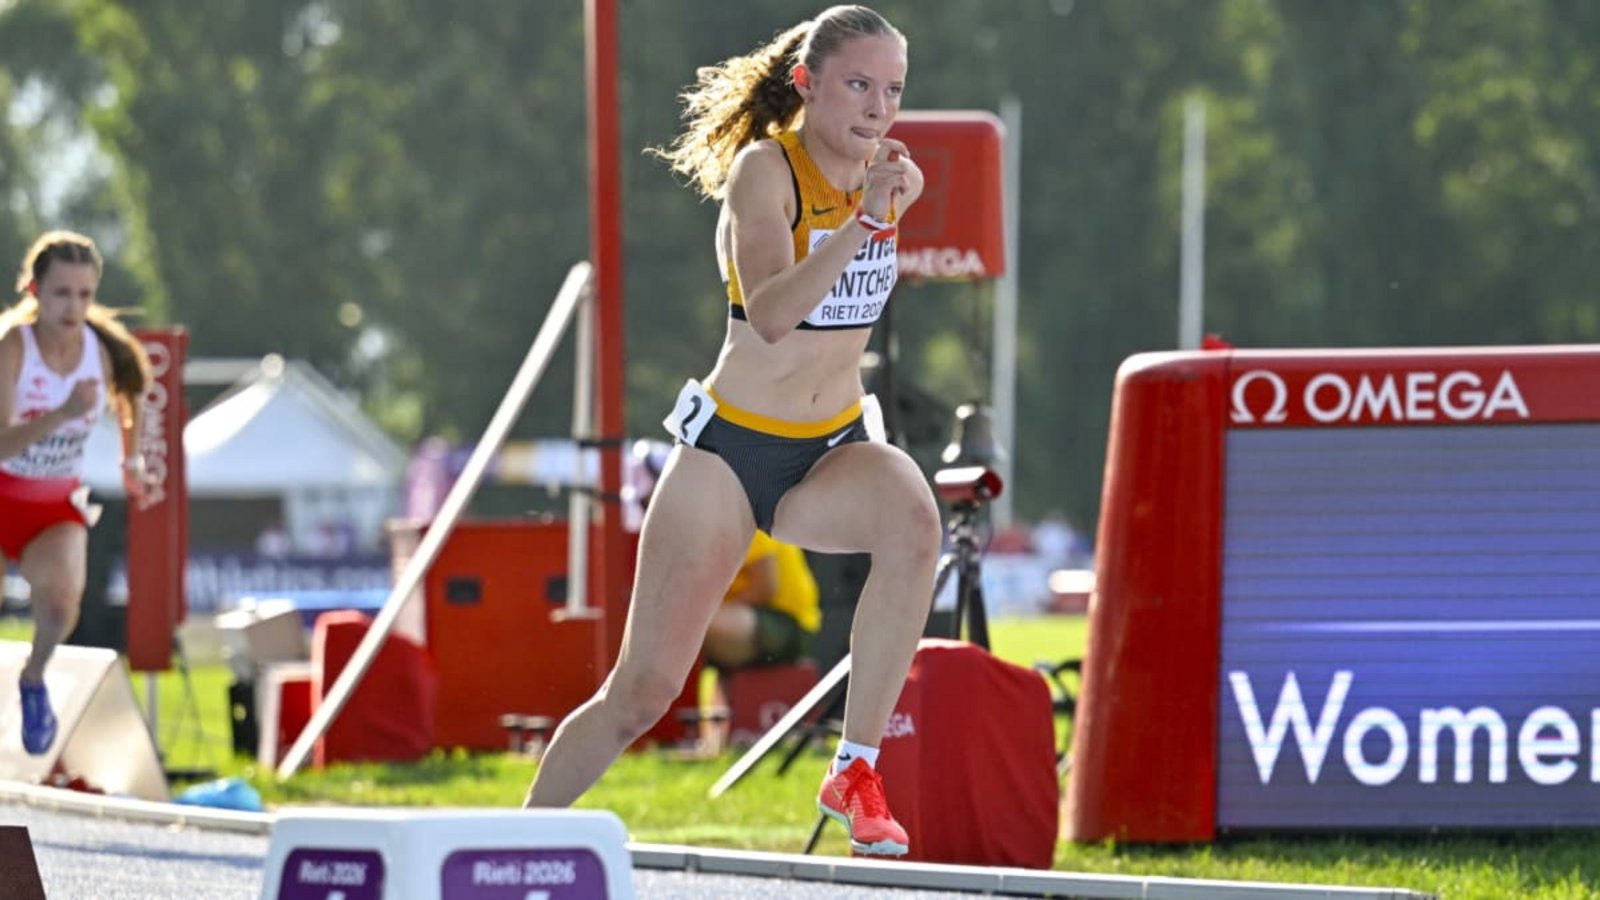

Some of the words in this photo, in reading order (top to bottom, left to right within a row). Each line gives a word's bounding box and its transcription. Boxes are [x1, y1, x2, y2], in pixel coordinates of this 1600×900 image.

[897, 246, 986, 277] MEGA
[821, 304, 860, 320] RIETI
[861, 300, 884, 319] 202
[1303, 370, 1530, 423] OMEGA
[1228, 671, 1600, 785] Wome
[473, 861, 521, 886] Rieti
[523, 860, 576, 885] 2026
